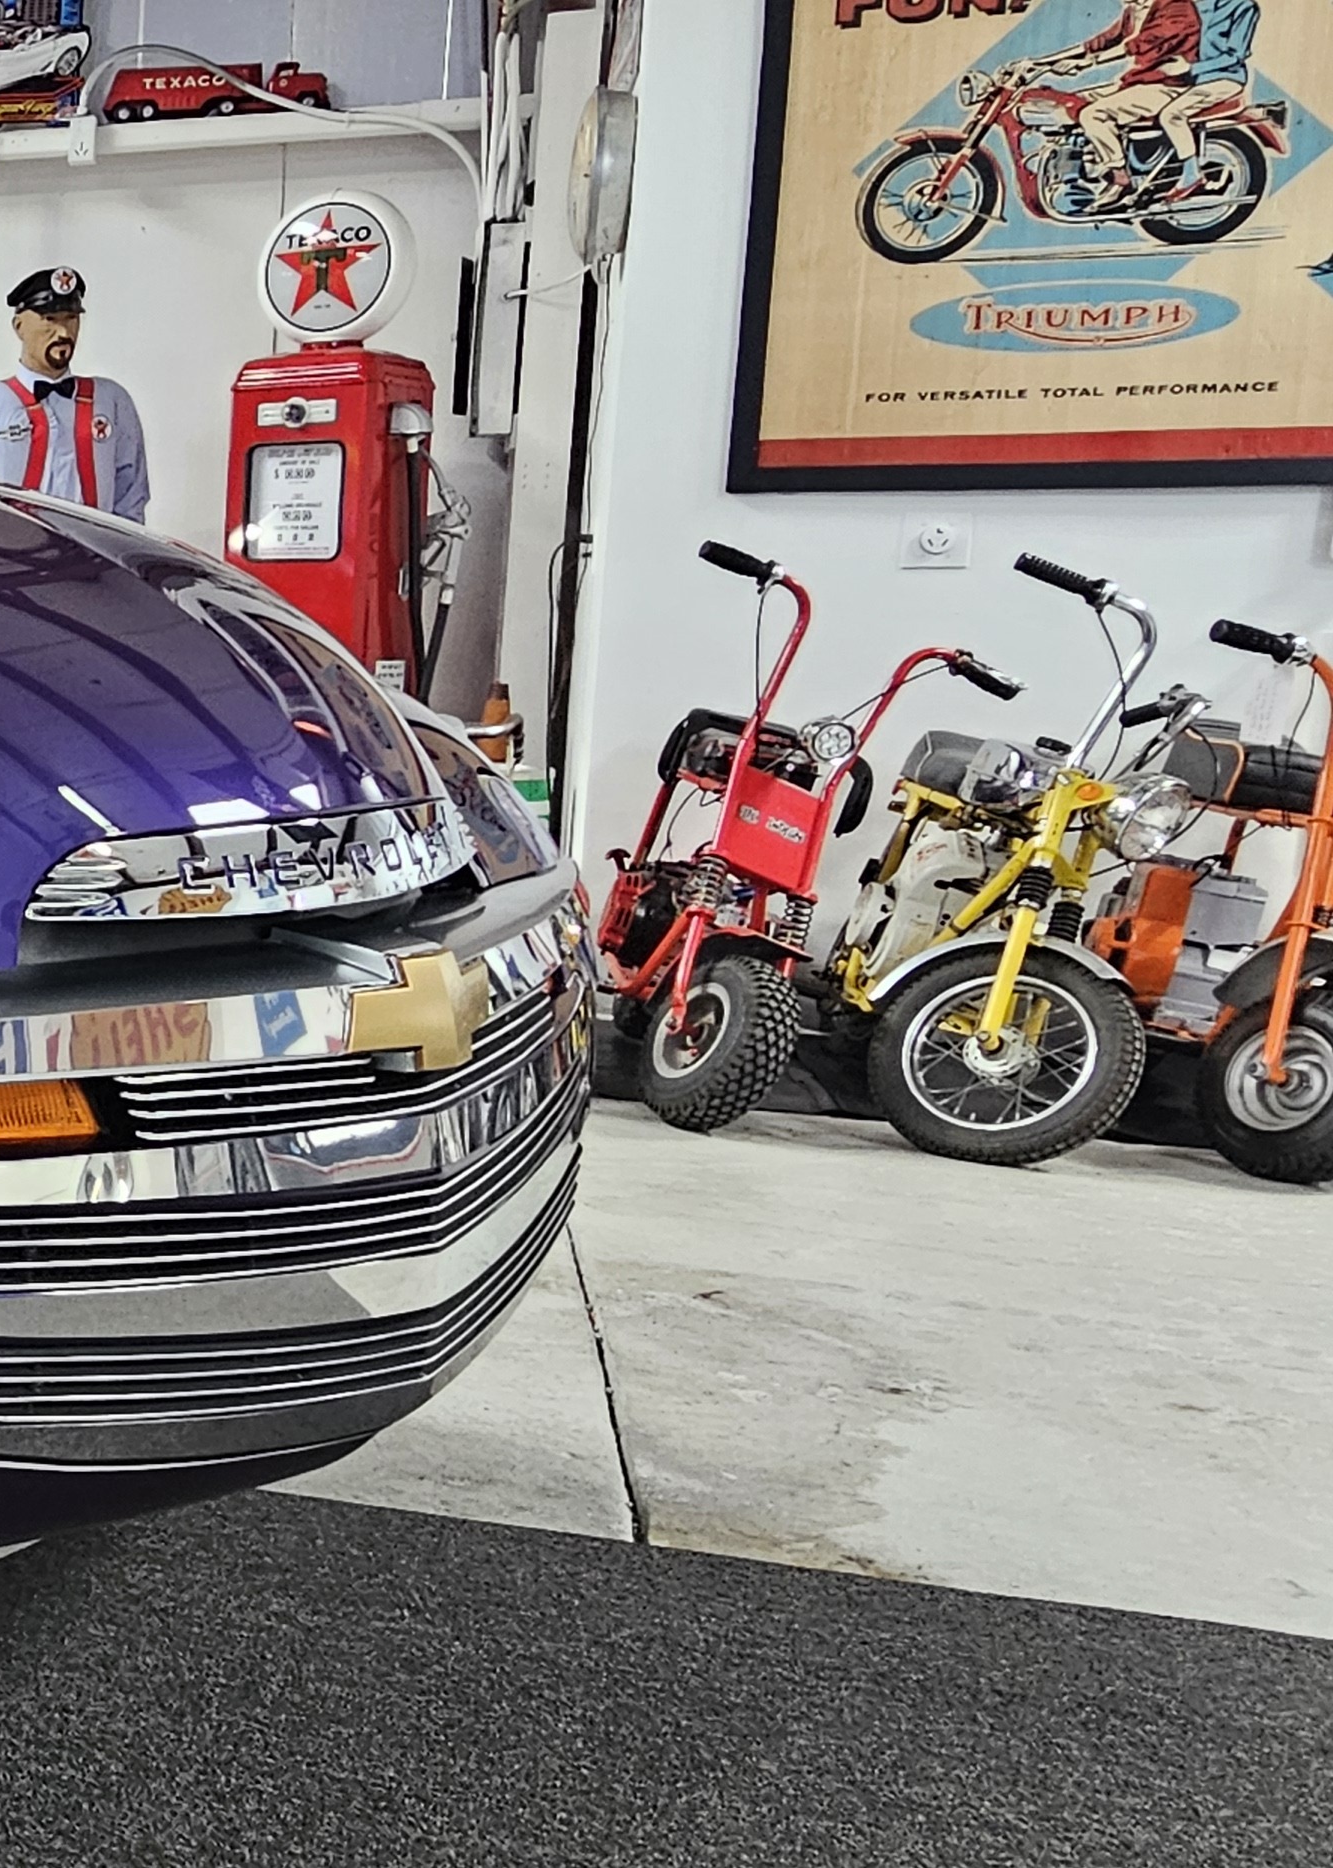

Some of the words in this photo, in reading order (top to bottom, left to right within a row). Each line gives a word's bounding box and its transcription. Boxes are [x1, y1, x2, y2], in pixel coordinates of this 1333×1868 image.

[142, 74, 226, 90] TEXACO
[286, 225, 372, 250] TECO
[965, 302, 1189, 336] TRIUMPH
[864, 391, 906, 404] FOR
[917, 387, 1029, 402] VERSATILE
[1040, 386, 1105, 398] TOTAL
[1115, 380, 1280, 397] PERFORMANCE
